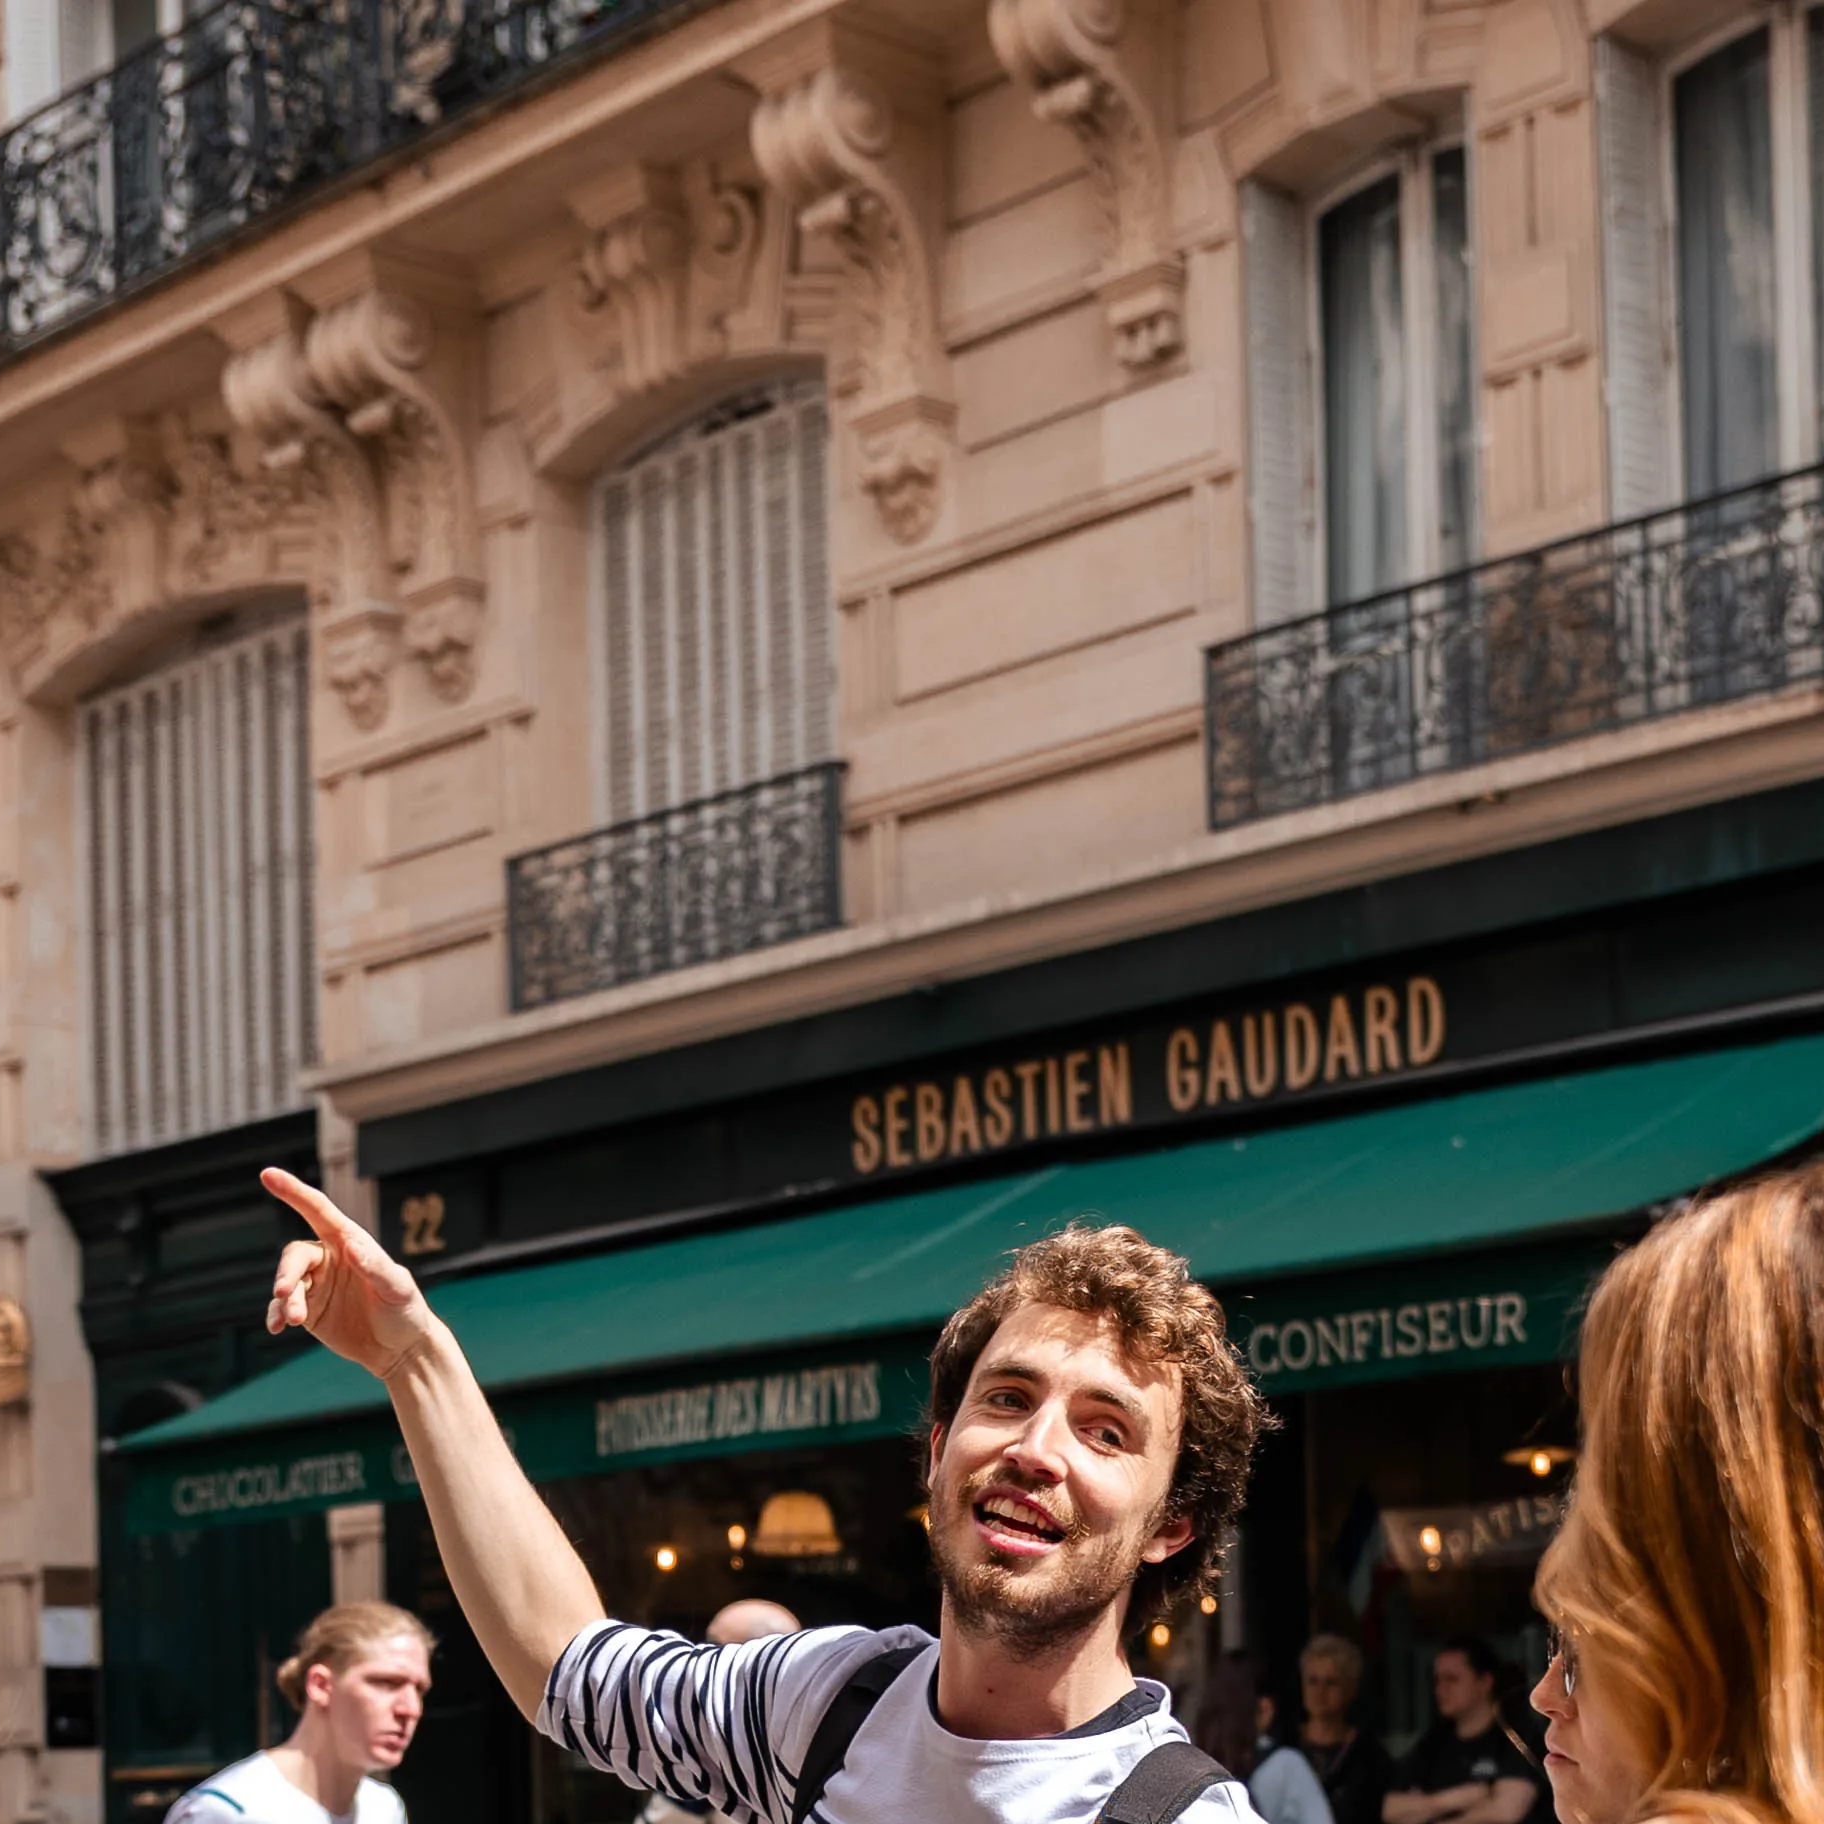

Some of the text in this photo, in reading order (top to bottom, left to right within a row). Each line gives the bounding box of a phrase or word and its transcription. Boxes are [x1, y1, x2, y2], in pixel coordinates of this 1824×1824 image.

[852, 976, 1446, 1174] SEBASTIEN GAUDARD
[401, 1193, 446, 1254] 22
[1249, 1292, 1527, 1375] CONFISEUR
[172, 1451, 366, 1516] CHOCOLATIER
[1445, 1493, 1565, 1567] PATIS
